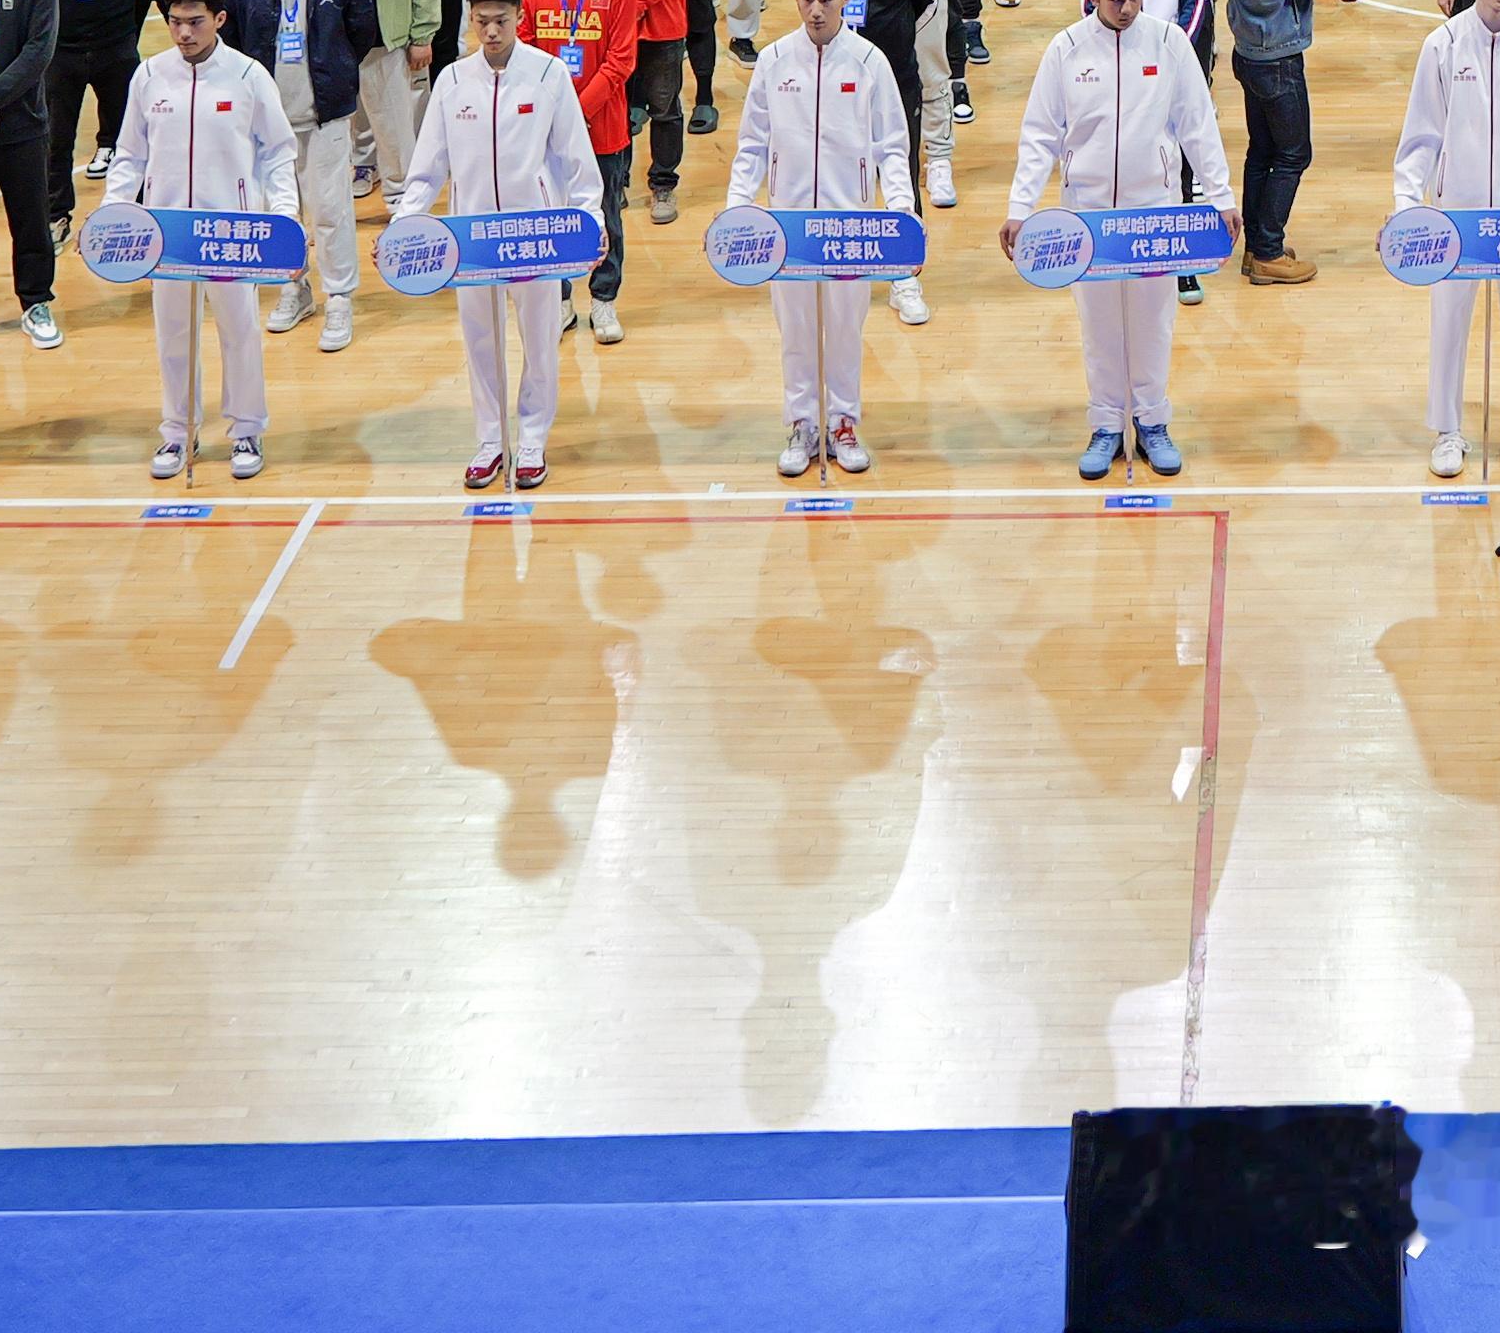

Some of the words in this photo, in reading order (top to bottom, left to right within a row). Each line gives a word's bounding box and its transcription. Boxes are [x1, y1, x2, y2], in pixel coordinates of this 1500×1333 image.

[193, 220, 271, 240] 吐鲁番市
[471, 217, 581, 240] 昌吉回族自治州
[805, 218, 900, 237] 阿勒泰地区
[1100, 213, 1220, 237] 伊犁哈萨克自治州
[200, 242, 262, 263] 代表队
[497, 239, 558, 260] 代表队
[823, 241, 883, 261] 代表队
[1131, 236, 1190, 258] 代表队
